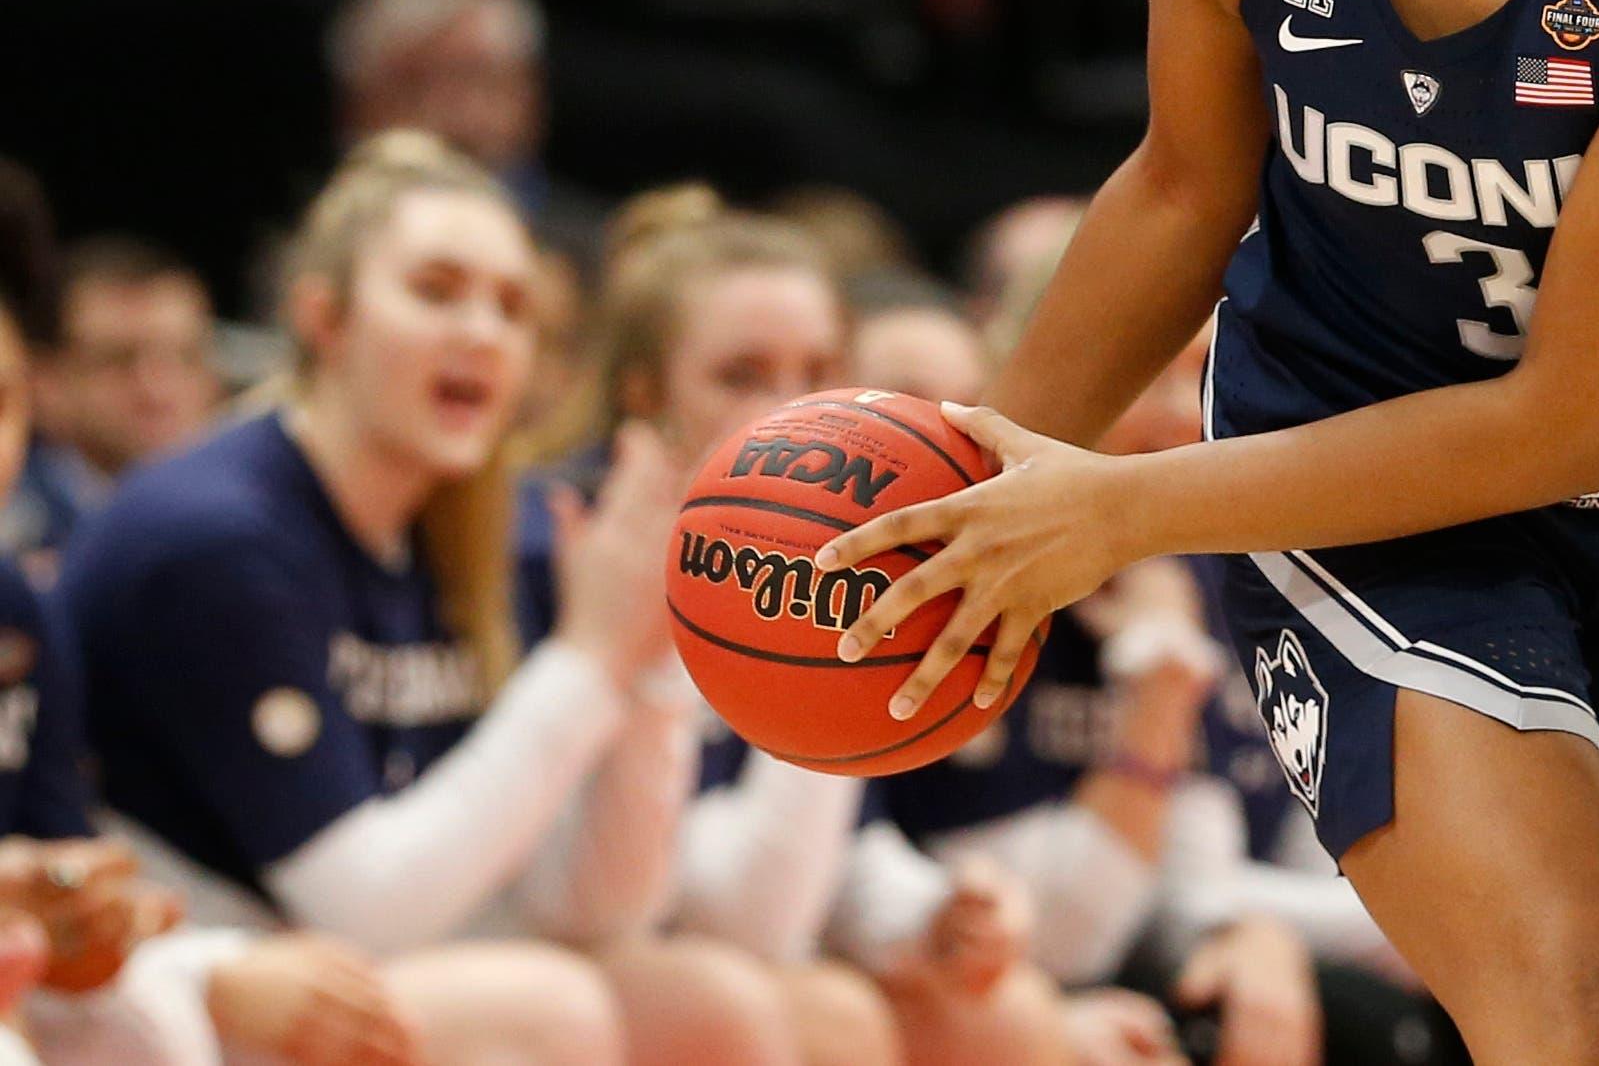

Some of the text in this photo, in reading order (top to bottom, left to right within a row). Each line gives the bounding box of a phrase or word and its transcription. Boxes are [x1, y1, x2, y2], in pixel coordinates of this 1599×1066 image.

[1547, 11, 1573, 25] FINAL
[1422, 230, 1538, 361] 3
[729, 436, 901, 509] NCAA
[679, 530, 896, 640] Wilson
